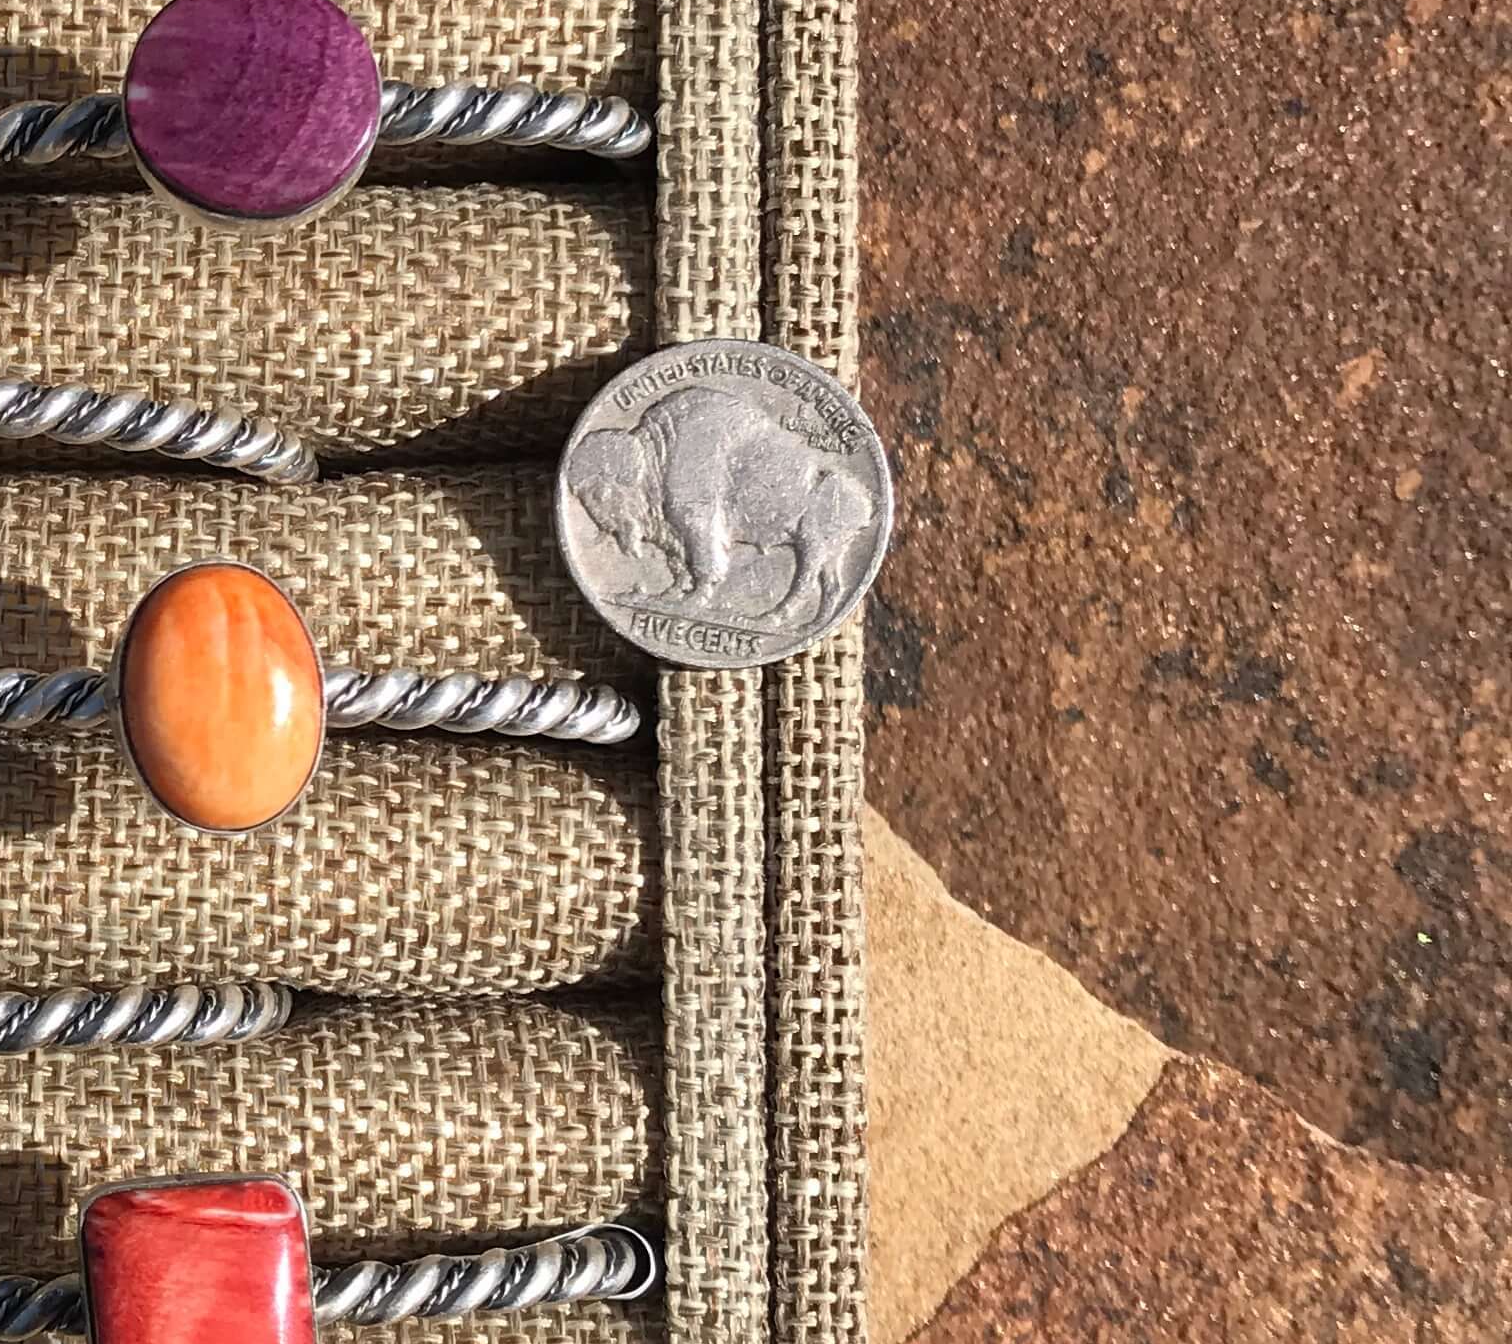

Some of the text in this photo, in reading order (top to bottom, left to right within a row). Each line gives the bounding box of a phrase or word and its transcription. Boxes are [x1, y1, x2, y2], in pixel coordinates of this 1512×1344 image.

[612, 361, 689, 412] UNITED
[689, 352, 768, 378] STATES
[767, 364, 801, 390] OF
[630, 611, 763, 658] FIVE CENTS
